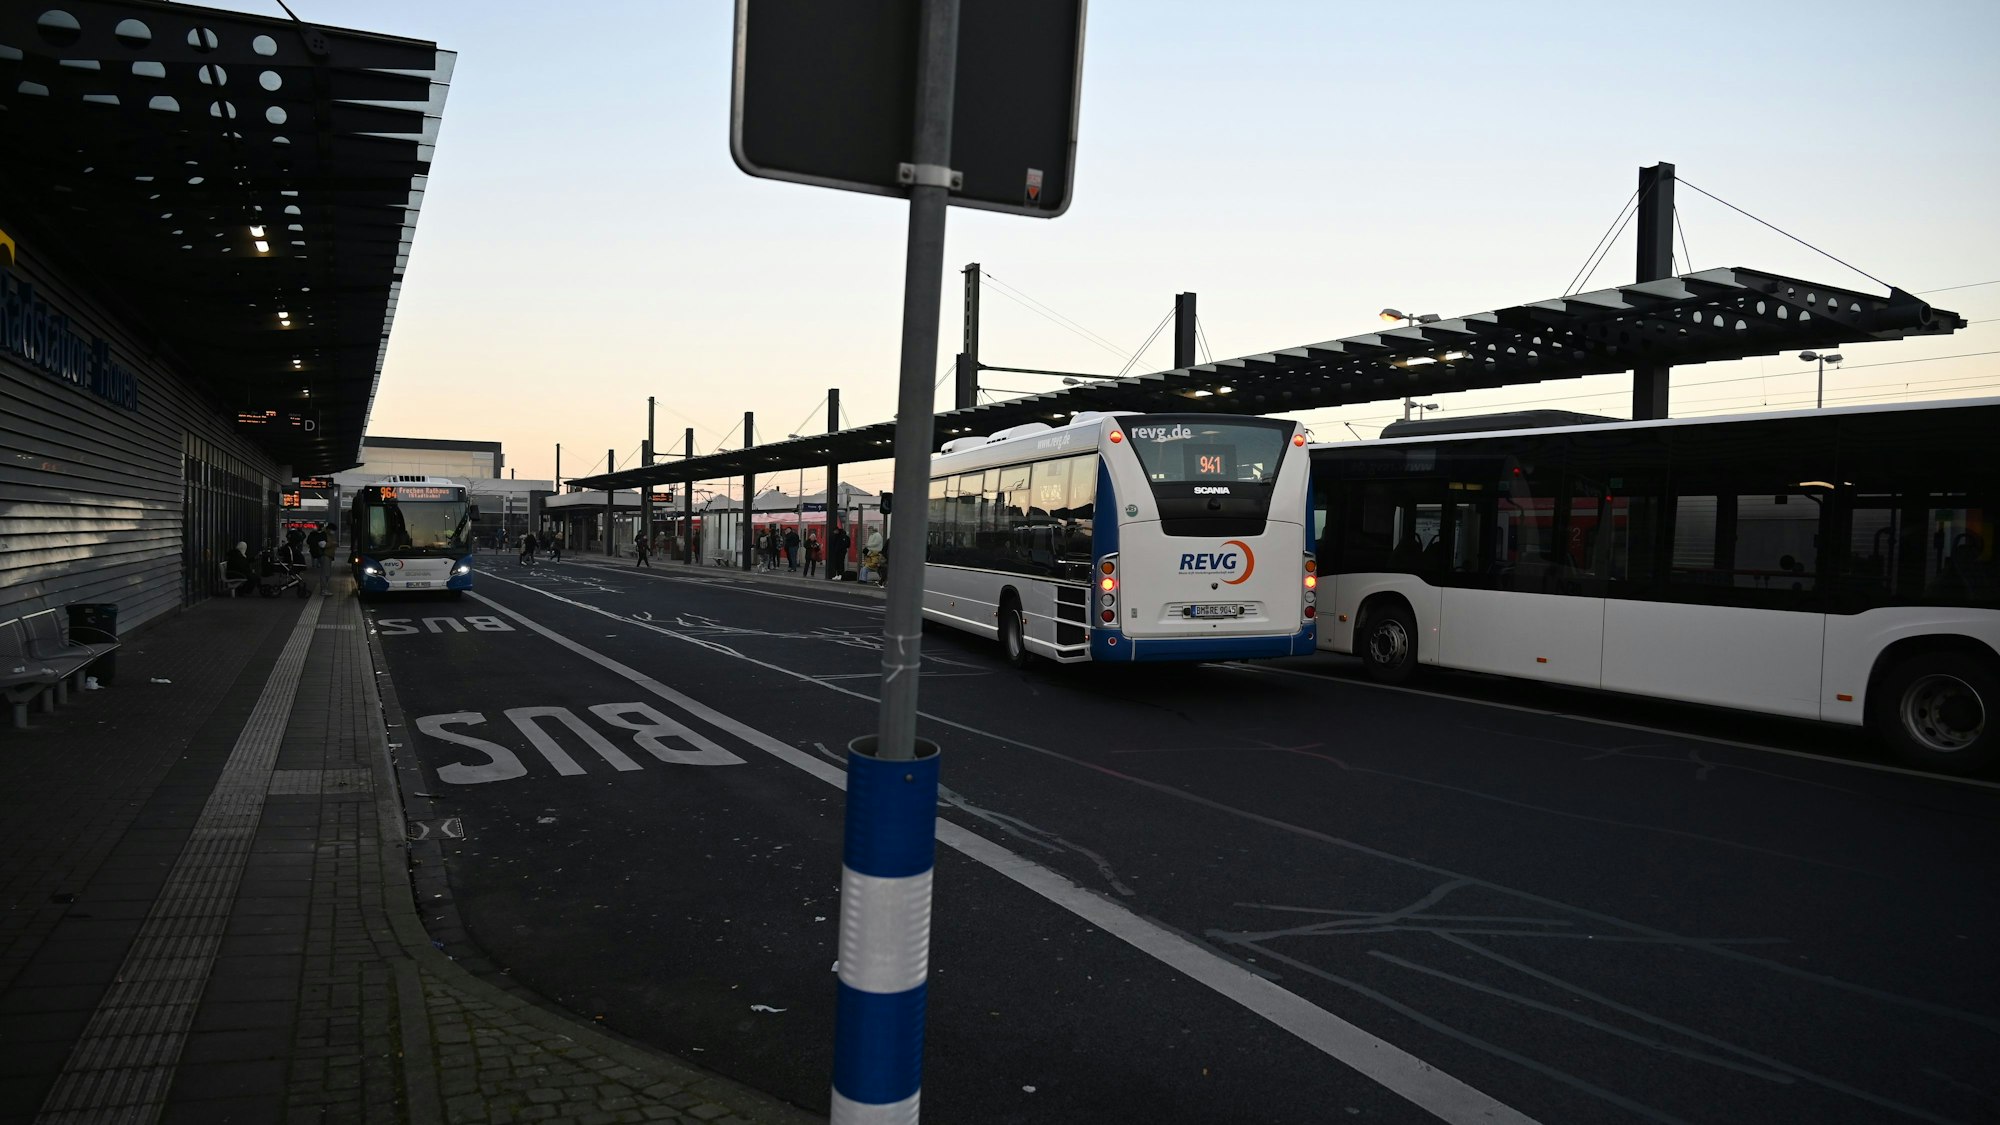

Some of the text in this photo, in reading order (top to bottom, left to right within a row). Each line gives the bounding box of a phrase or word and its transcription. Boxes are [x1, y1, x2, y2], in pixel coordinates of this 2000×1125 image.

[304, 419, 316, 432] D
[1131, 424, 1192, 442] revg.de
[1037, 431, 1071, 450] www.revg.de
[1200, 456, 1221, 474] 941
[380, 487, 397, 499] 964
[1194, 486, 1230, 495] SCANIA
[1179, 553, 1237, 571] REVG
[1196, 606, 1206, 615] BM
[1209, 606, 1219, 615] RE
[377, 615, 516, 635] BUS
[415, 702, 748, 784] BUS
